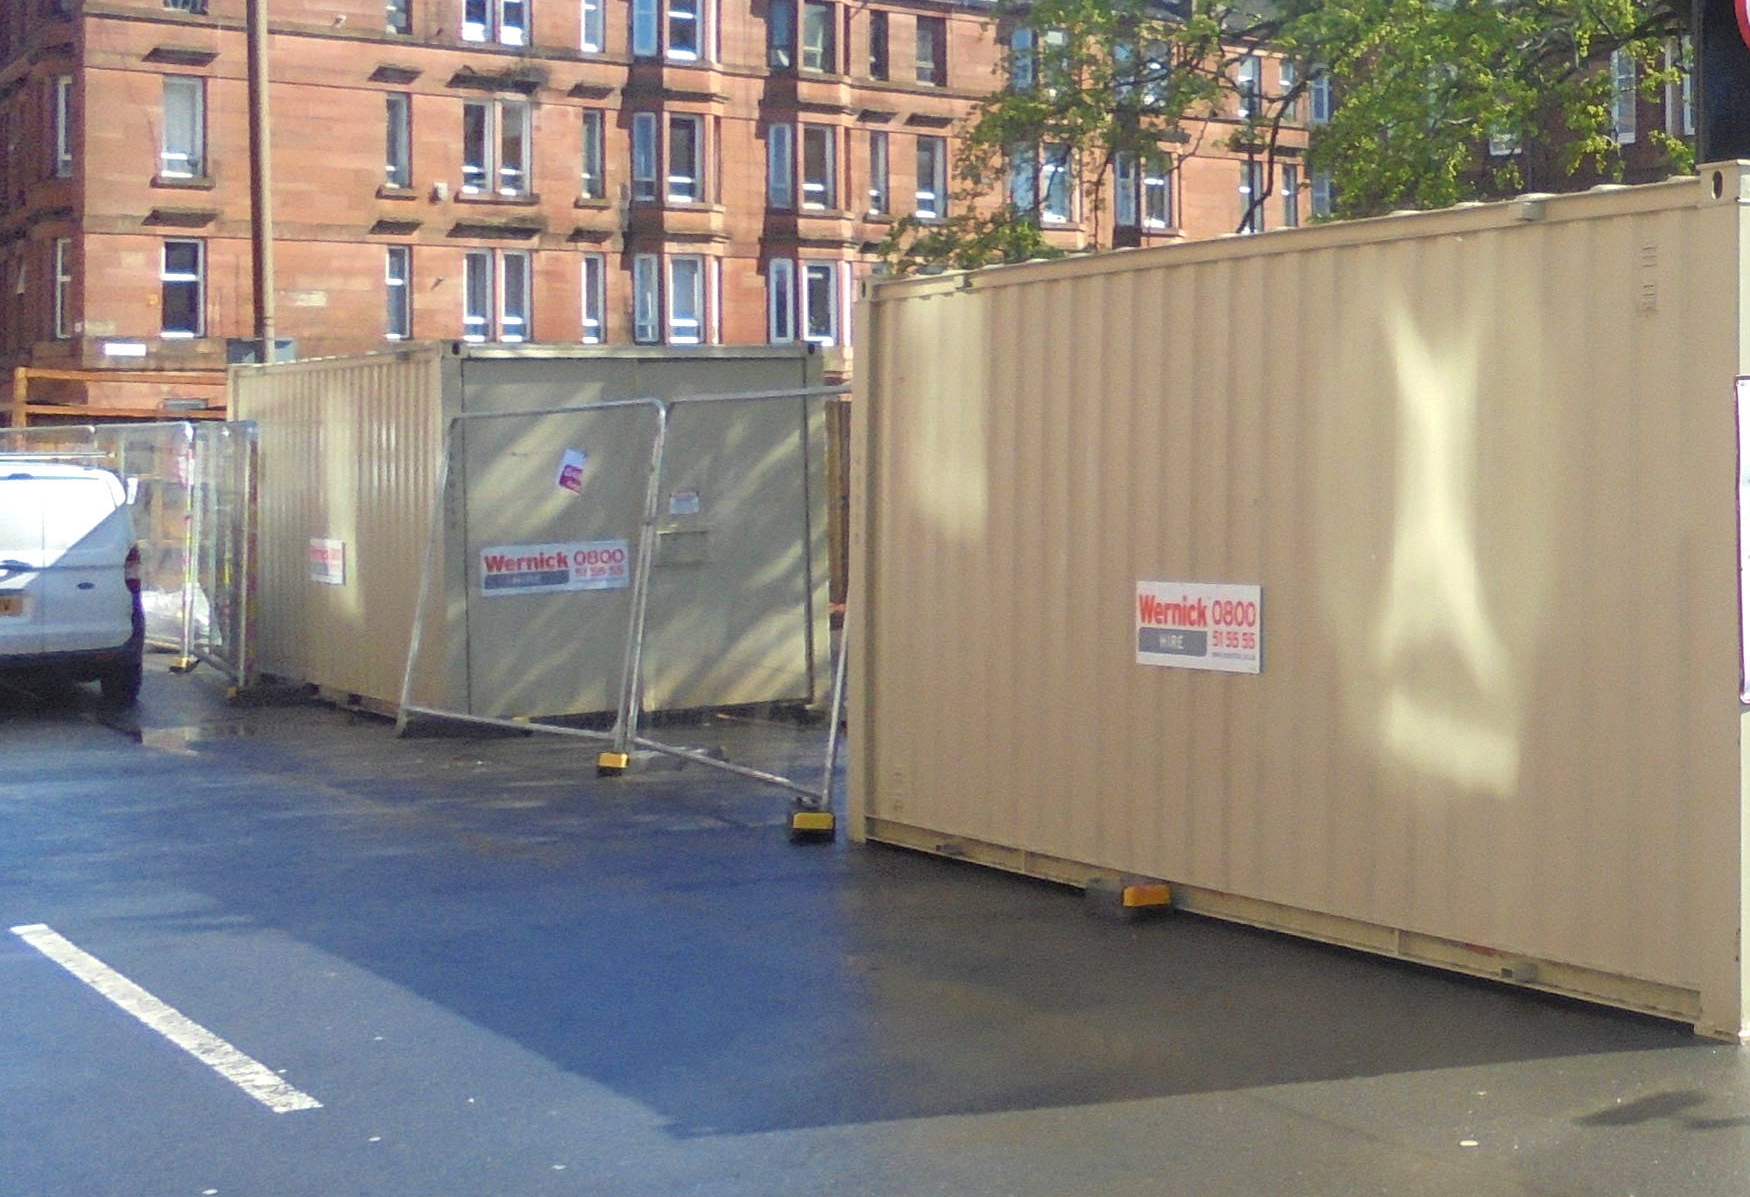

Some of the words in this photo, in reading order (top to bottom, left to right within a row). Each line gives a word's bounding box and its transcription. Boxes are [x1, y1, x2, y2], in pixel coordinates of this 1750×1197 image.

[484, 551, 569, 572] Wernick
[573, 548, 625, 566] 0800
[1139, 593, 1208, 628] Wernick
[1212, 600, 1257, 628] 0800
[1212, 630, 1223, 647] 51
[1225, 631, 1239, 648] 55
[1242, 632, 1256, 650] 55
